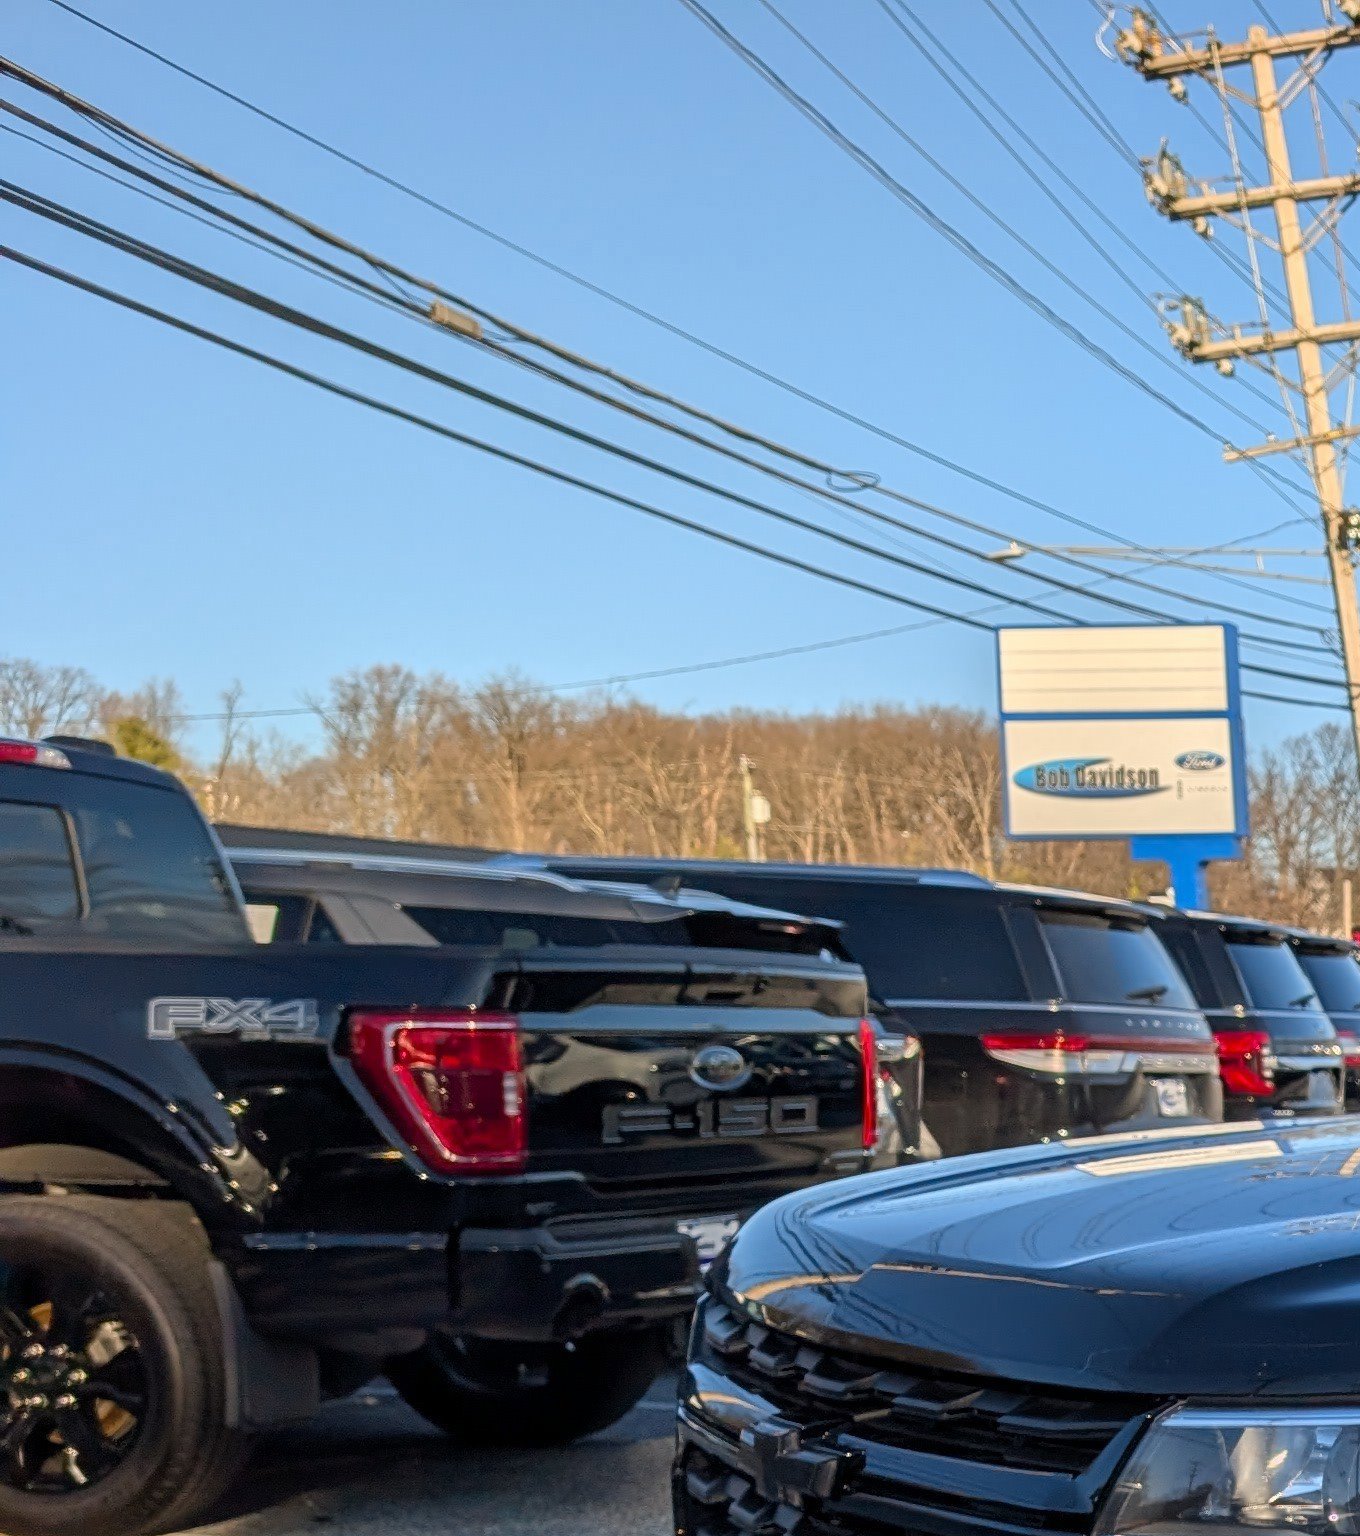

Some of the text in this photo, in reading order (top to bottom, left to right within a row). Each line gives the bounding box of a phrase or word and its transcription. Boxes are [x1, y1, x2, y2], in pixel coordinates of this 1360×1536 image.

[1035, 764, 1070, 788] Bob
[1075, 763, 1160, 789] Davidson
[1182, 753, 1219, 769] Ford
[148, 997, 319, 1040] FX4
[602, 1097, 819, 1143] F-150
